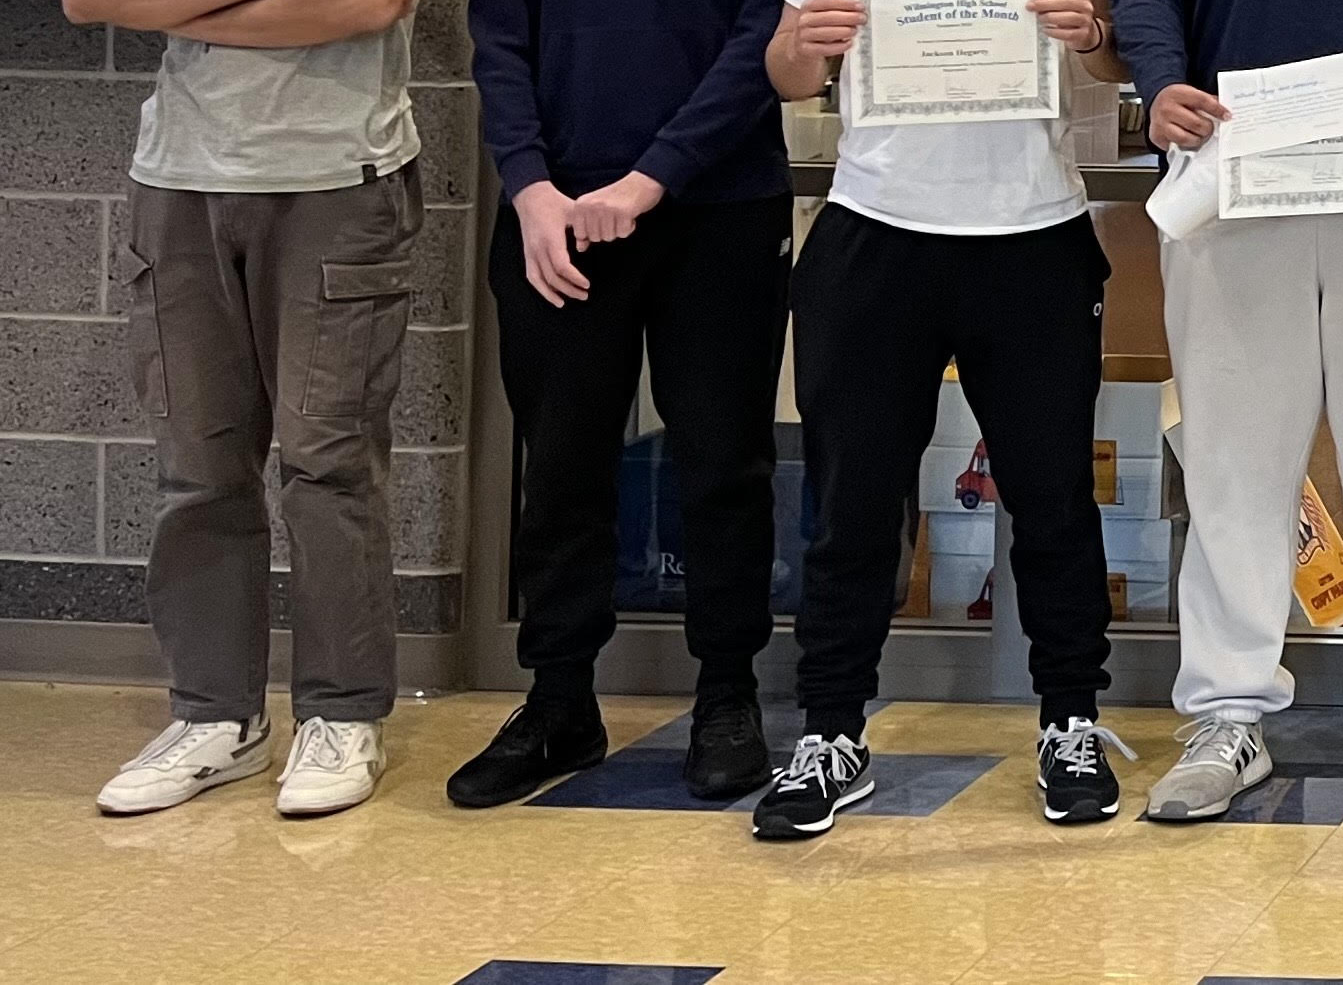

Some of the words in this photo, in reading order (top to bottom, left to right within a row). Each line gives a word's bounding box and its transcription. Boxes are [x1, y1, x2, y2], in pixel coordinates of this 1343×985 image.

[956, 0, 977, 8] High
[896, 12, 942, 27] Student
[945, 9, 957, 19] of
[960, 9, 978, 19] the
[982, 9, 1019, 22] Month
